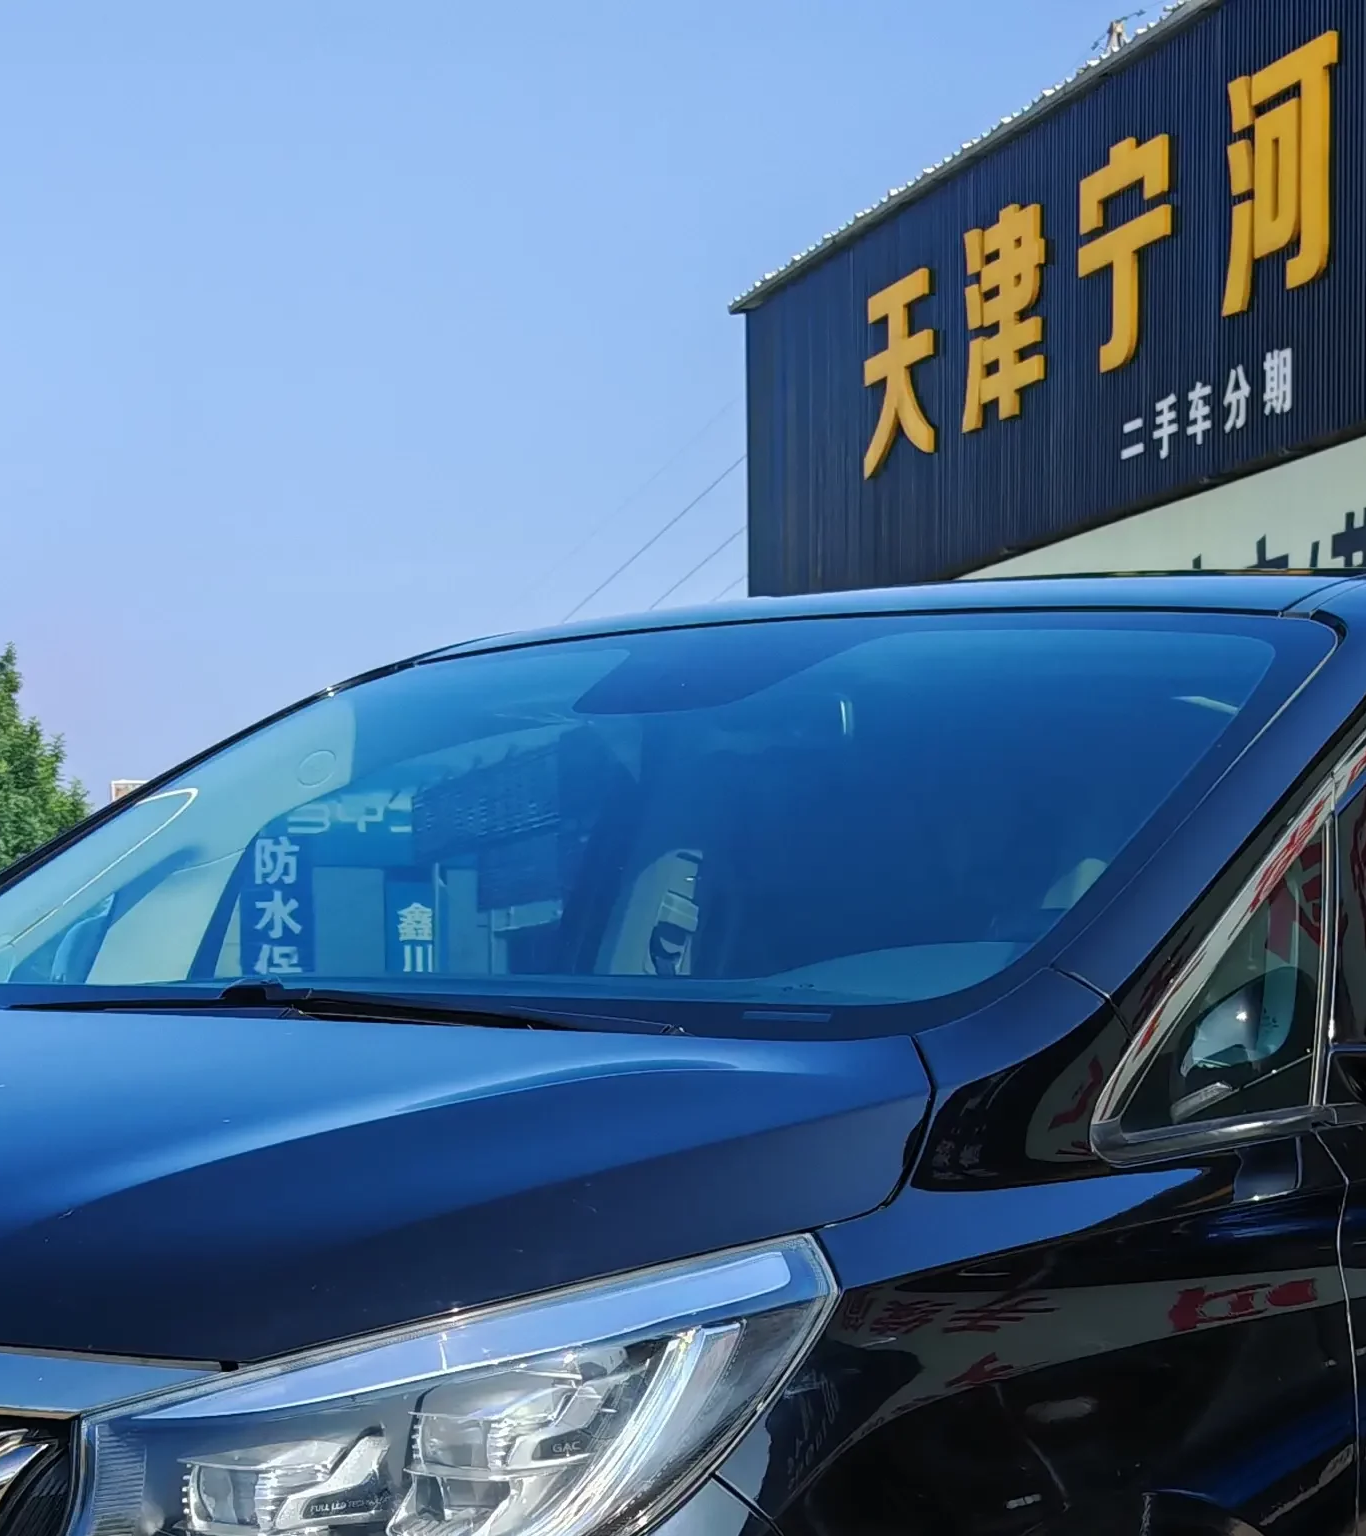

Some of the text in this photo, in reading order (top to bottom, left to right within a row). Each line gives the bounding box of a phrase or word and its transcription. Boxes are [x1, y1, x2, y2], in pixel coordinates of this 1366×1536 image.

[1120, 348, 1294, 461] 二手车分期
[552, 1441, 581, 1453] GAC
